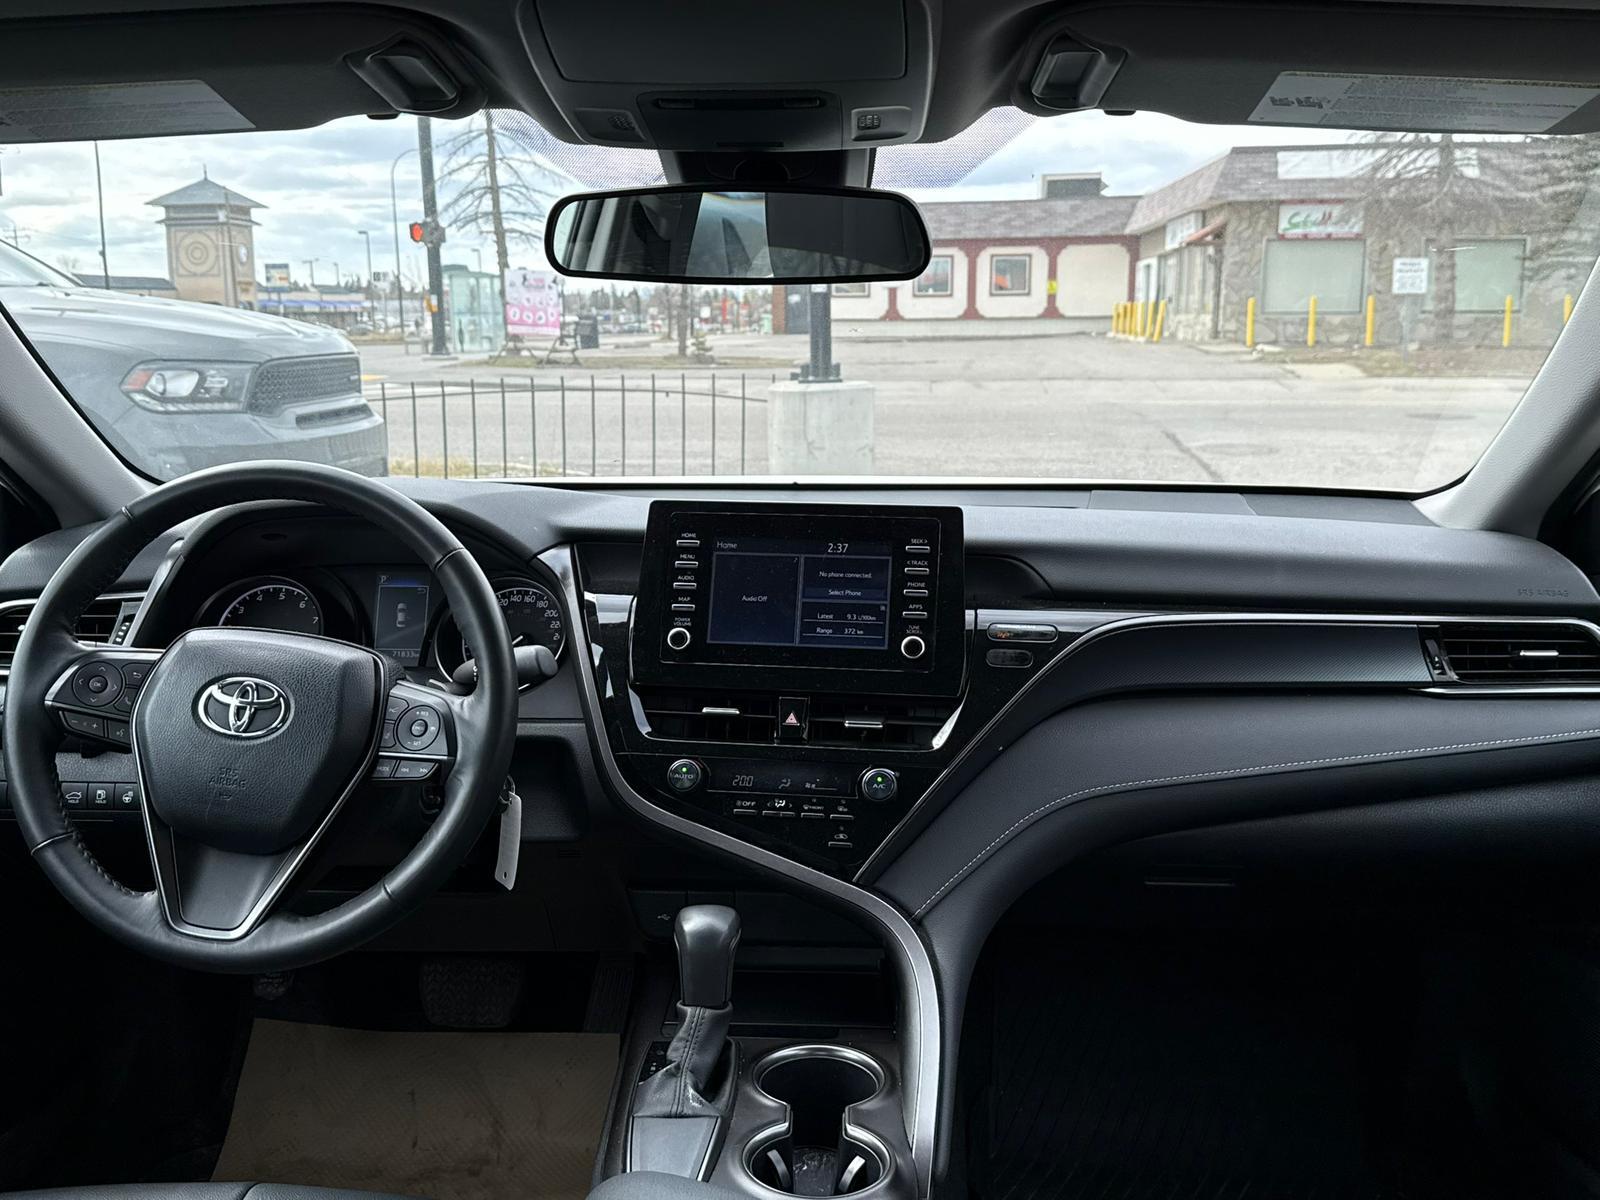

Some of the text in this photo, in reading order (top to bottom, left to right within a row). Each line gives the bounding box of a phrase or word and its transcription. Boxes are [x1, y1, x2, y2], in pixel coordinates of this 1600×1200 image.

[716, 541, 738, 550] Home
[827, 543, 849, 553] 2:37
[279, 592, 286, 600] 5
[510, 594, 522, 603] 140
[524, 595, 536, 603] 160
[742, 594, 757, 602] Audio
[299, 600, 306, 608] 6
[537, 600, 549, 609] 180
[237, 606, 244, 615] 3
[312, 616, 319, 625] 7
[817, 612, 834, 620] Latest
[816, 626, 833, 634] Range
[844, 627, 856, 635] 372
[673, 772, 695, 780] AUTO
